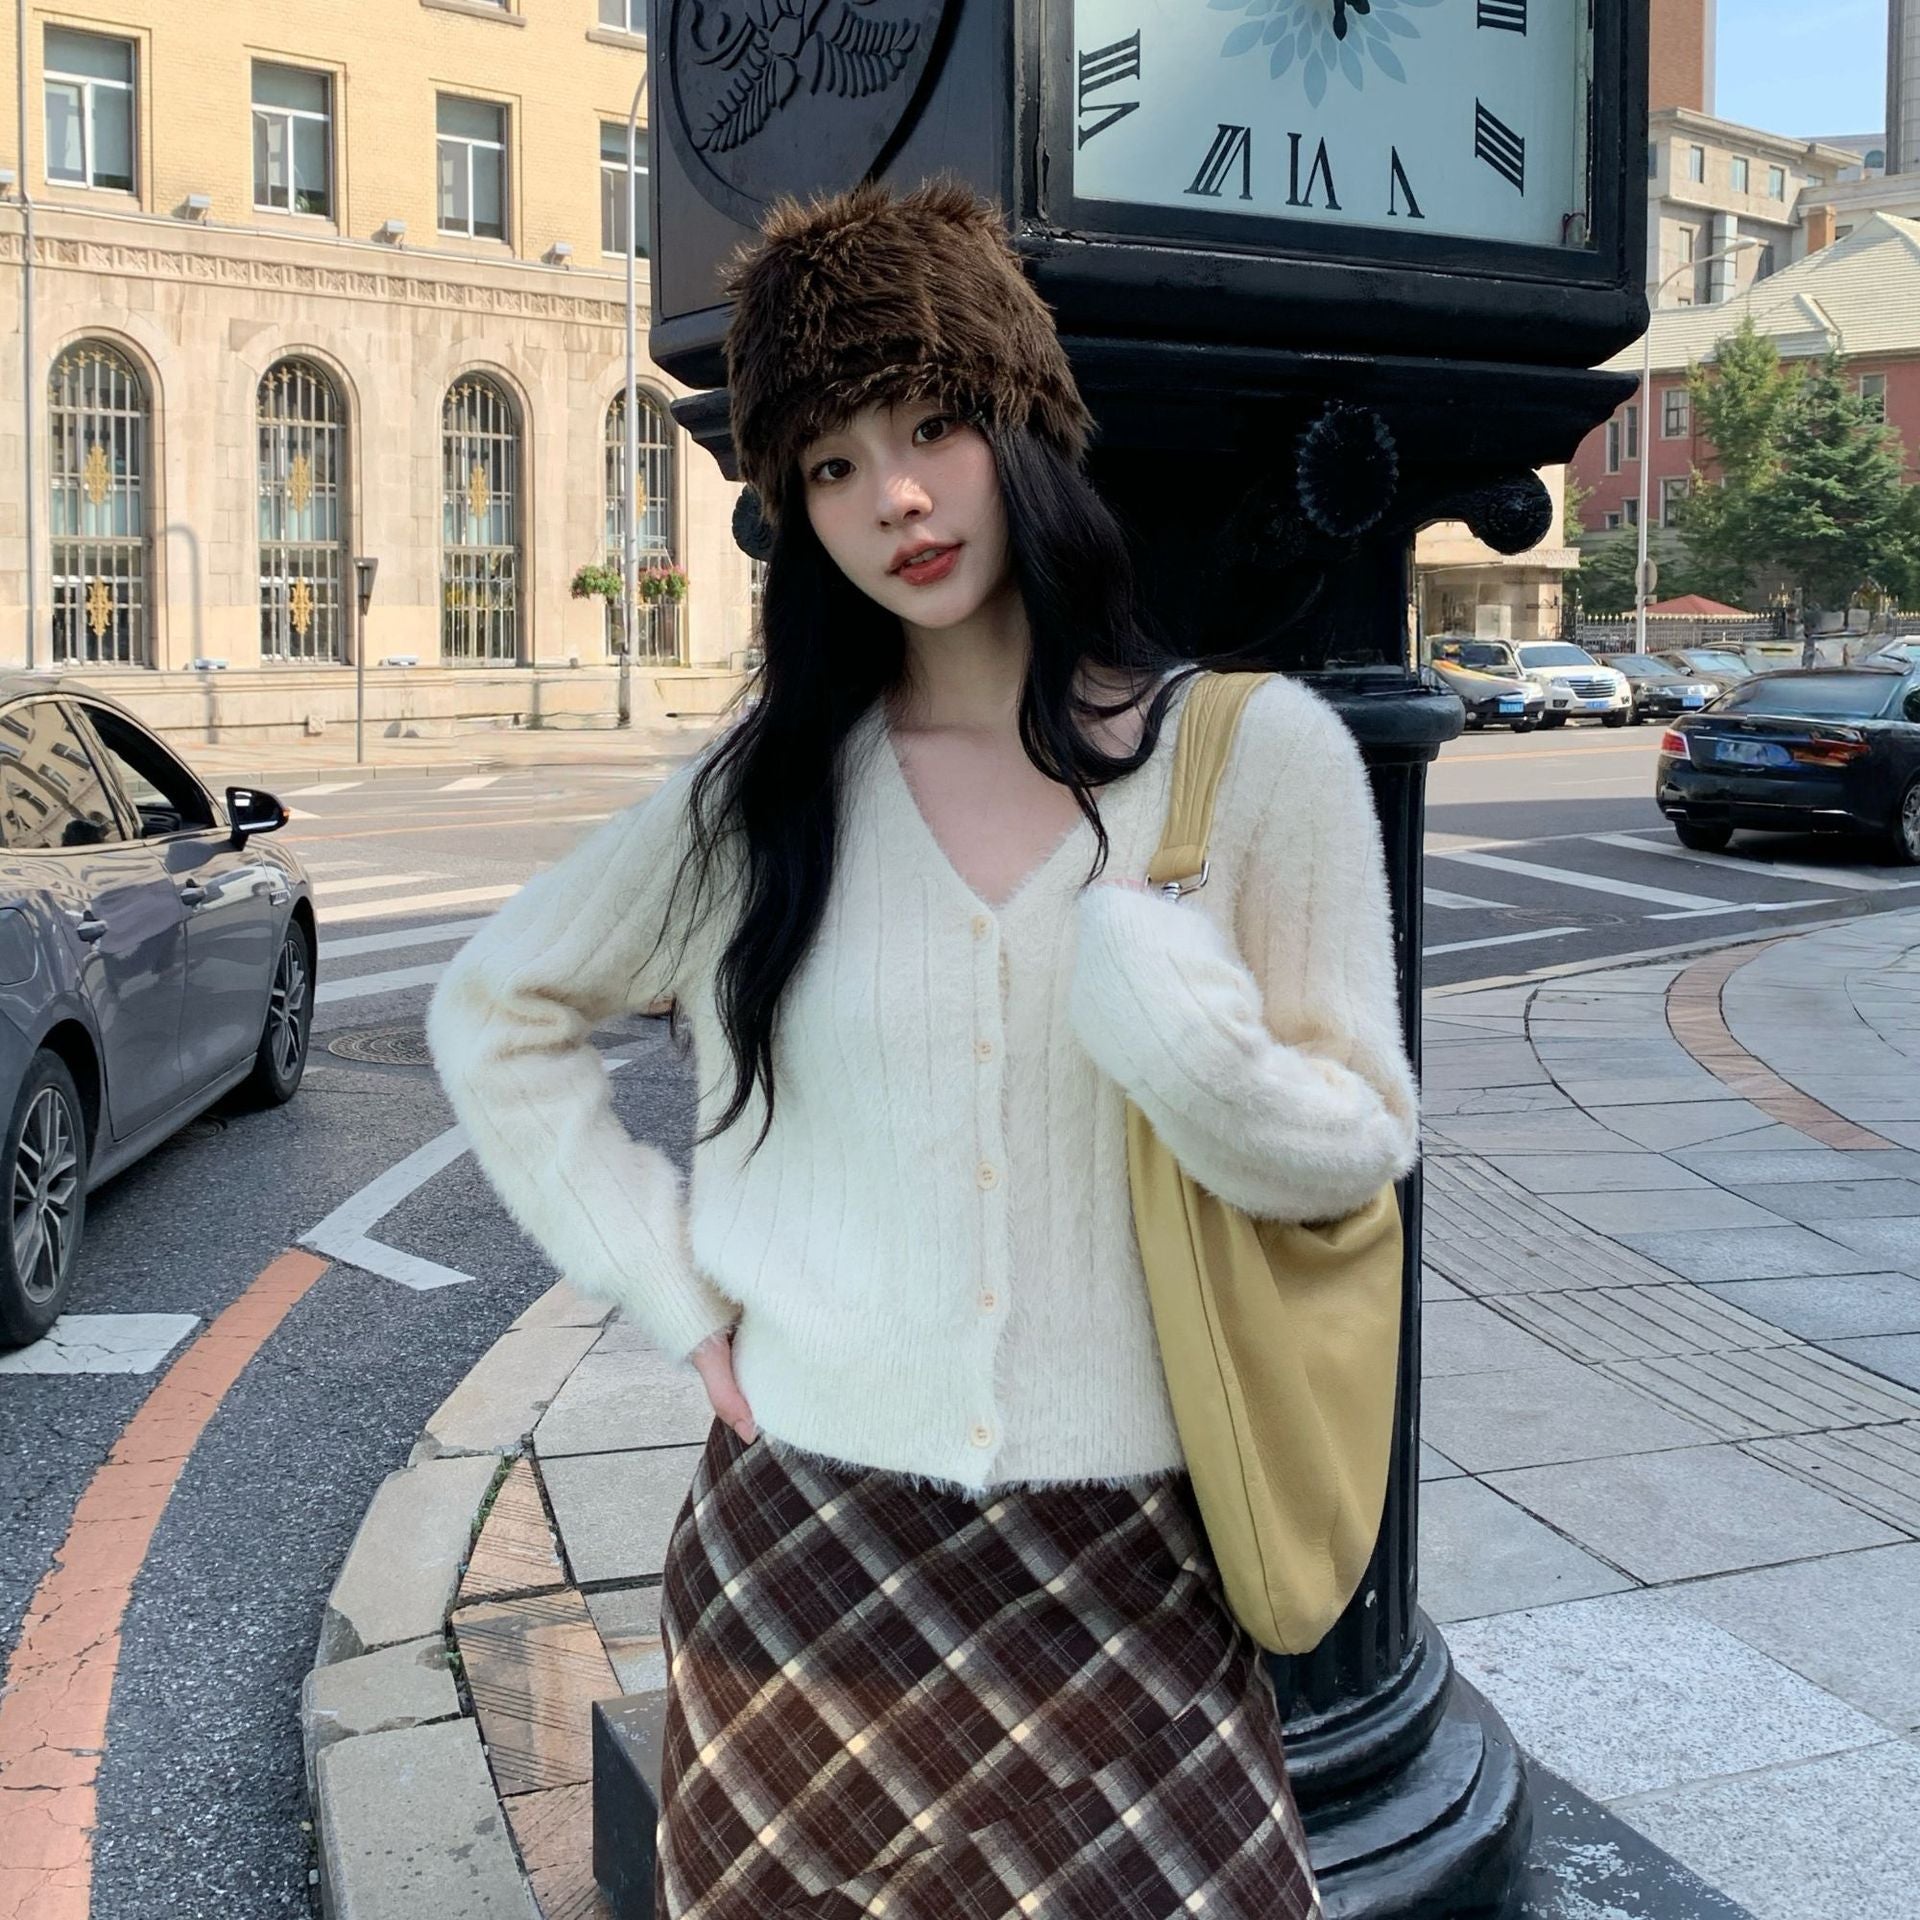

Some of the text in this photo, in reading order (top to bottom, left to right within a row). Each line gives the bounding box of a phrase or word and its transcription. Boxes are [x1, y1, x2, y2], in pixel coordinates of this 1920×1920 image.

[1477, 0, 1527, 37] II
[1078, 28, 1141, 151] VIII
[1184, 123, 1254, 201] VII
[1285, 132, 1343, 211] VI
[1387, 145, 1426, 219] V
[1474, 97, 1525, 198] IIII
